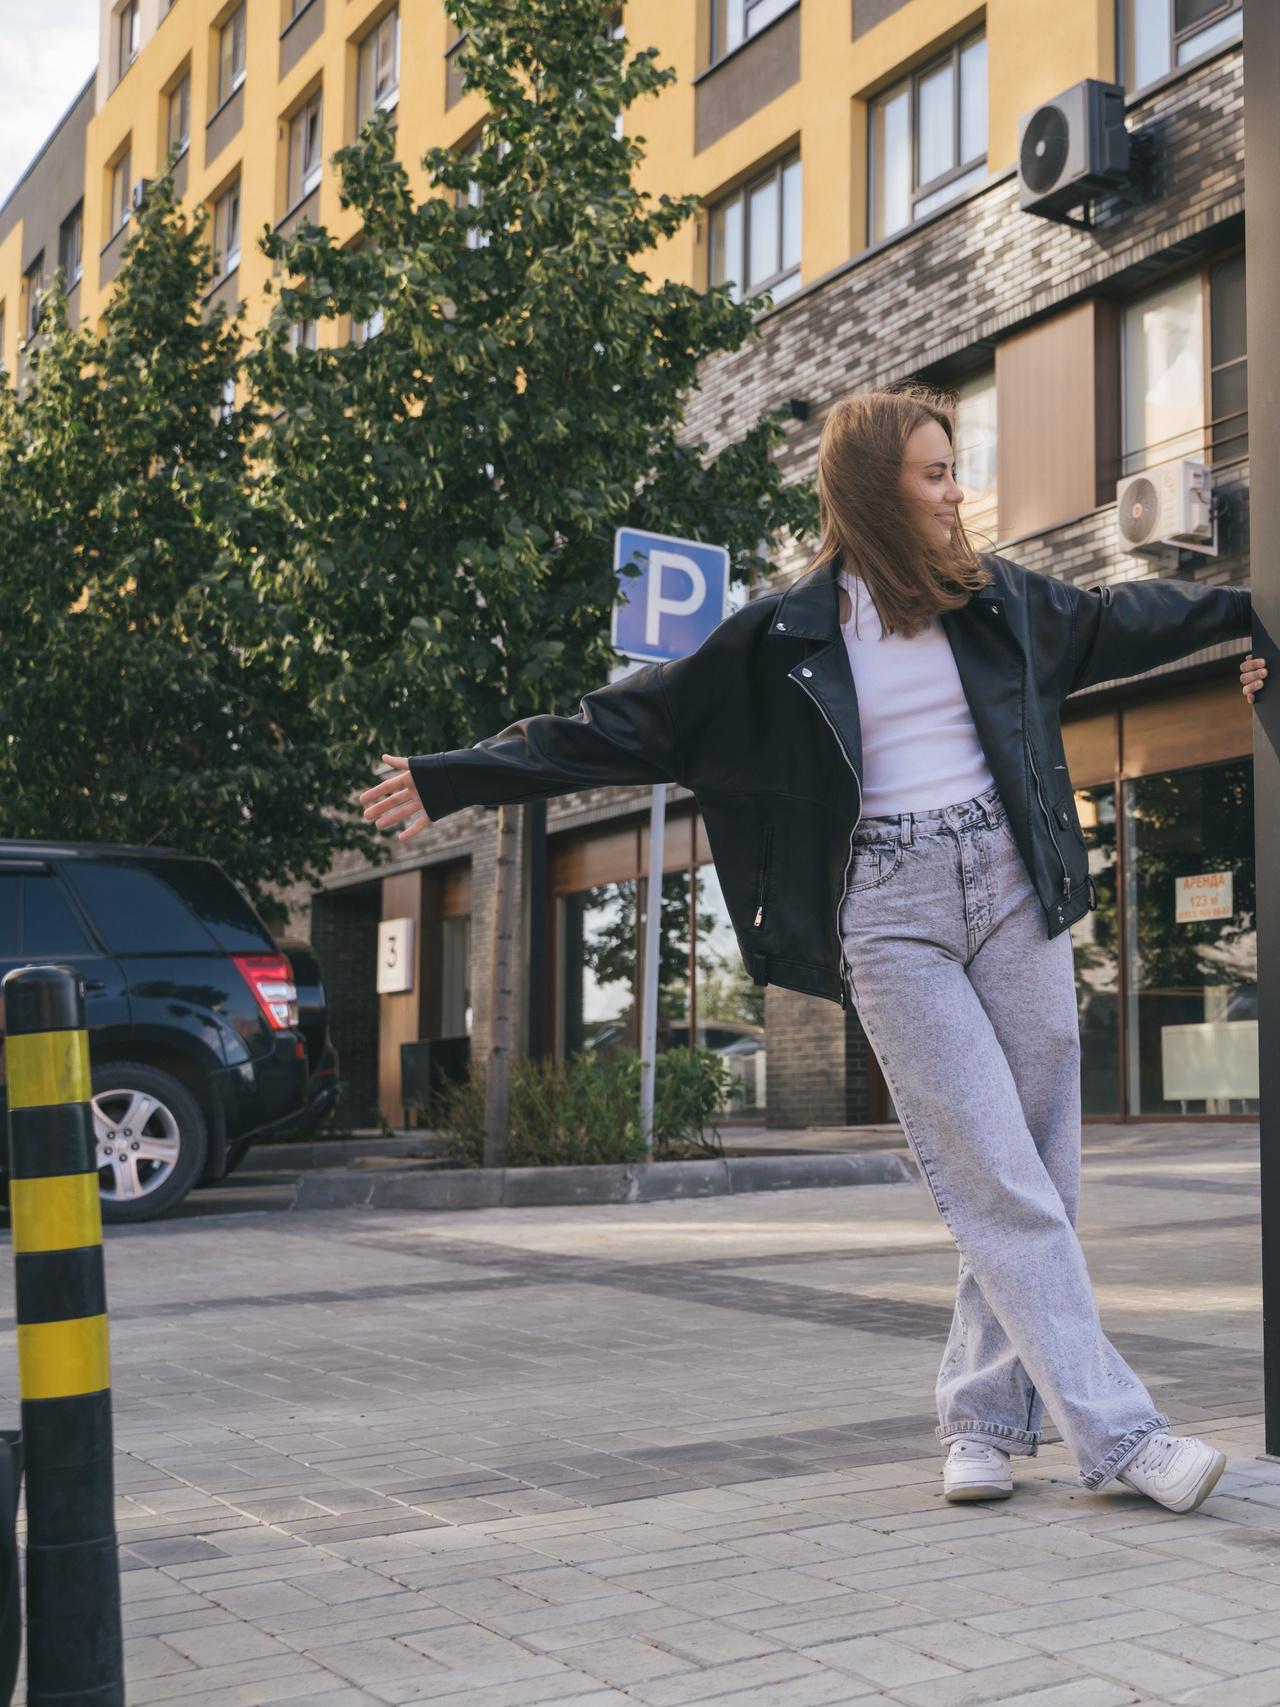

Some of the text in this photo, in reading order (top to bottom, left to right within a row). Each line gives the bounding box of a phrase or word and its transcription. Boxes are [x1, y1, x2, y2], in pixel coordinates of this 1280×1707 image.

[646, 549, 706, 646] P
[1183, 874, 1225, 889] АРЕНДА
[1190, 894, 1208, 908] 123
[387, 936, 398, 969] 3
